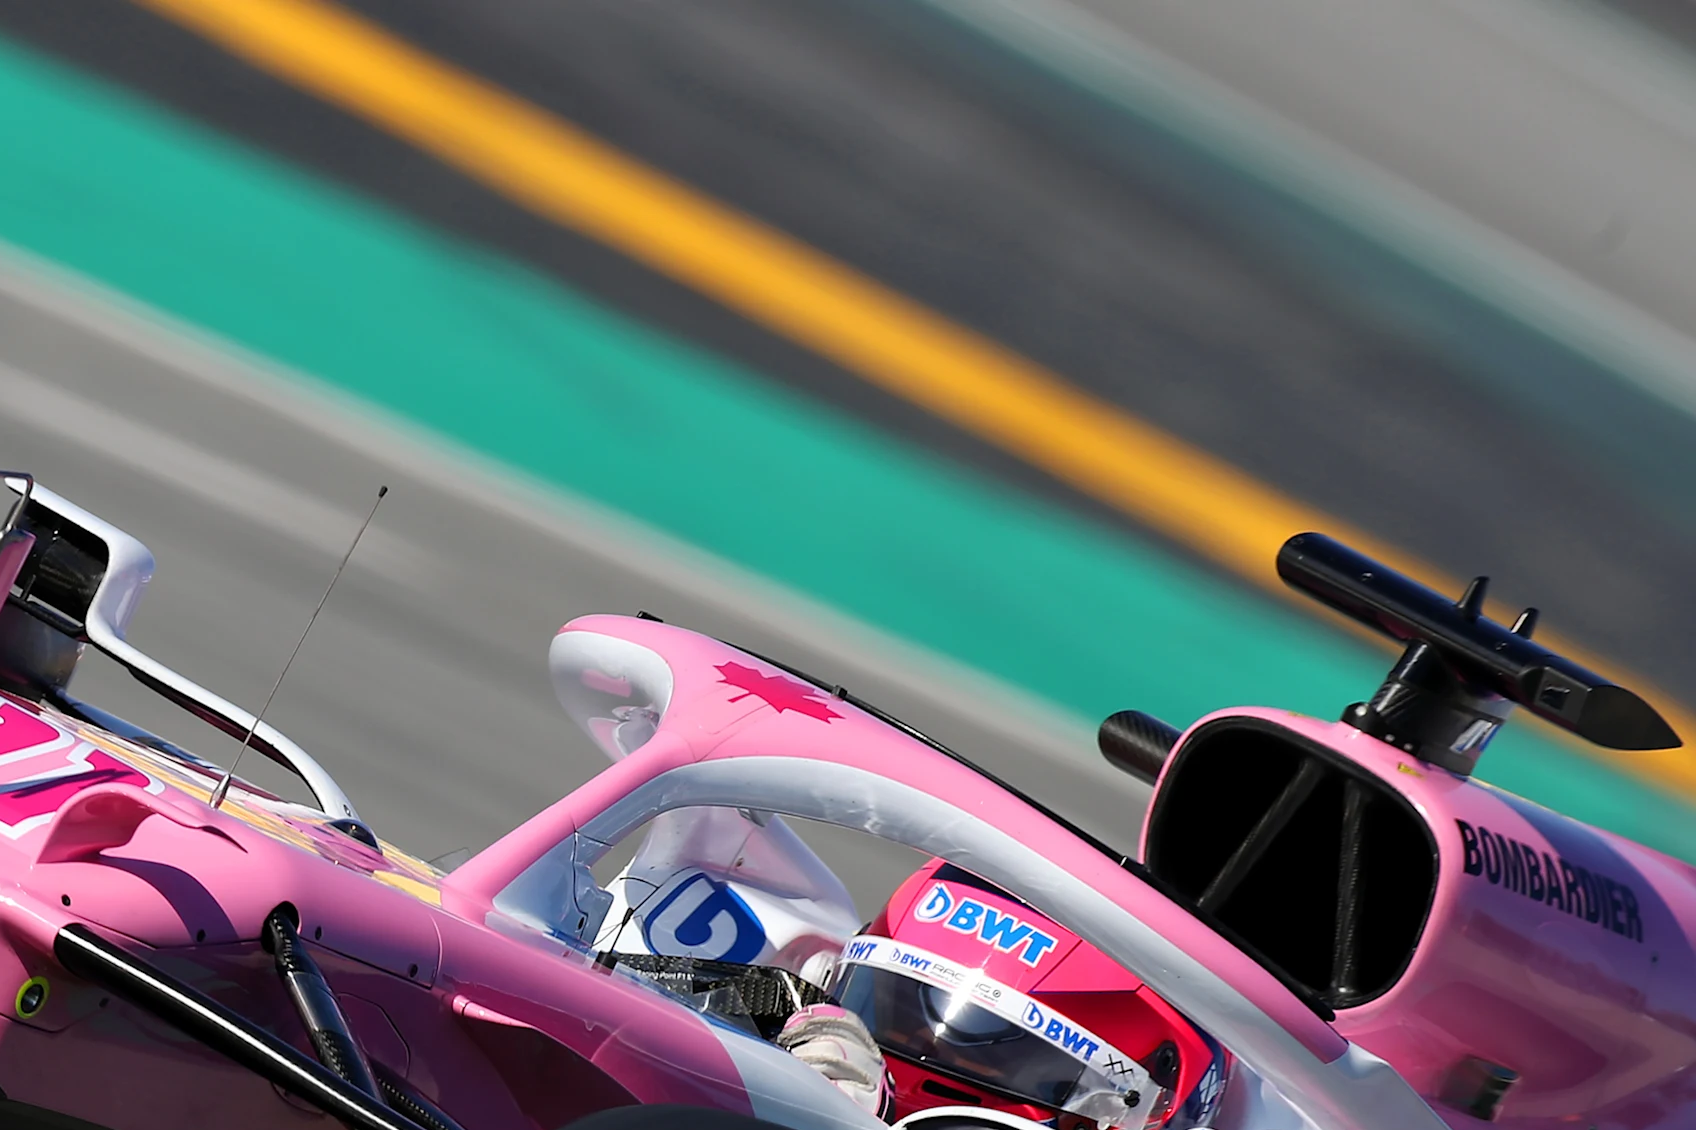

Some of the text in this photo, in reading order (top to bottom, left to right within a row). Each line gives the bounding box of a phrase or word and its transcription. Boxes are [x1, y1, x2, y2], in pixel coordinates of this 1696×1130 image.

[1454, 818, 1644, 943] BOMBARDIER
[947, 900, 1054, 964] BWT
[901, 953, 931, 971] BWT
[1044, 1018, 1099, 1061] BWT
